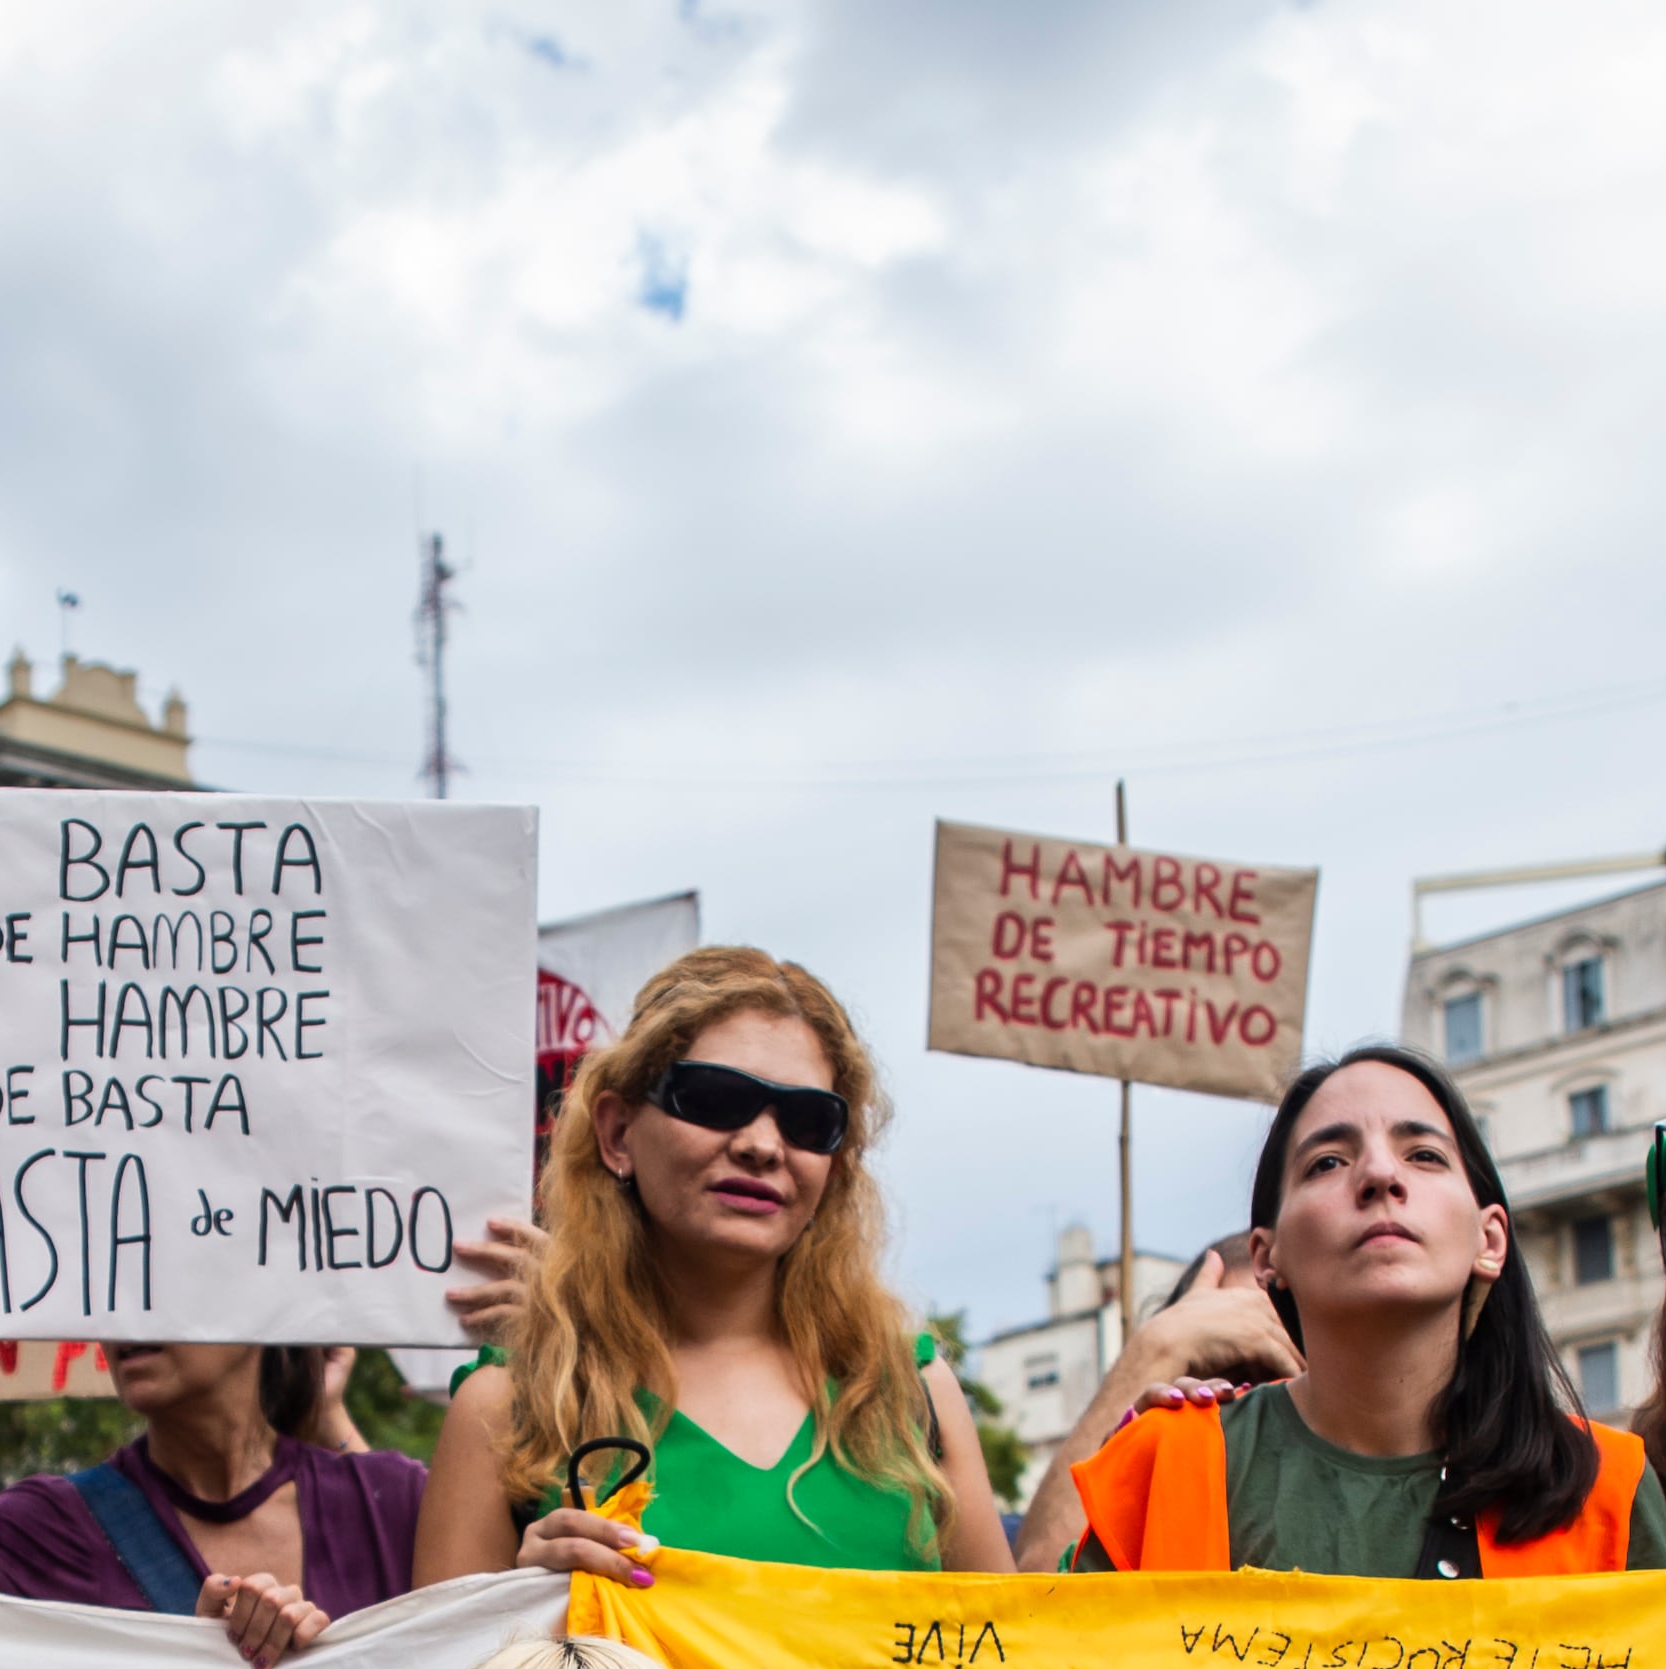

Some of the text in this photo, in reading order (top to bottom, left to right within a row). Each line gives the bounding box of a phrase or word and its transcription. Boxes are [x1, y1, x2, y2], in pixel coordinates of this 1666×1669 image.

[60, 818, 322, 902] BASTA
[999, 838, 1262, 924] HAMBRE
[61, 910, 327, 975] HAMBRE
[992, 911, 1055, 962] DE
[61, 979, 330, 1061] HAMBRE
[63, 1070, 251, 1135] BASTA
[190, 1188, 234, 1238] de
